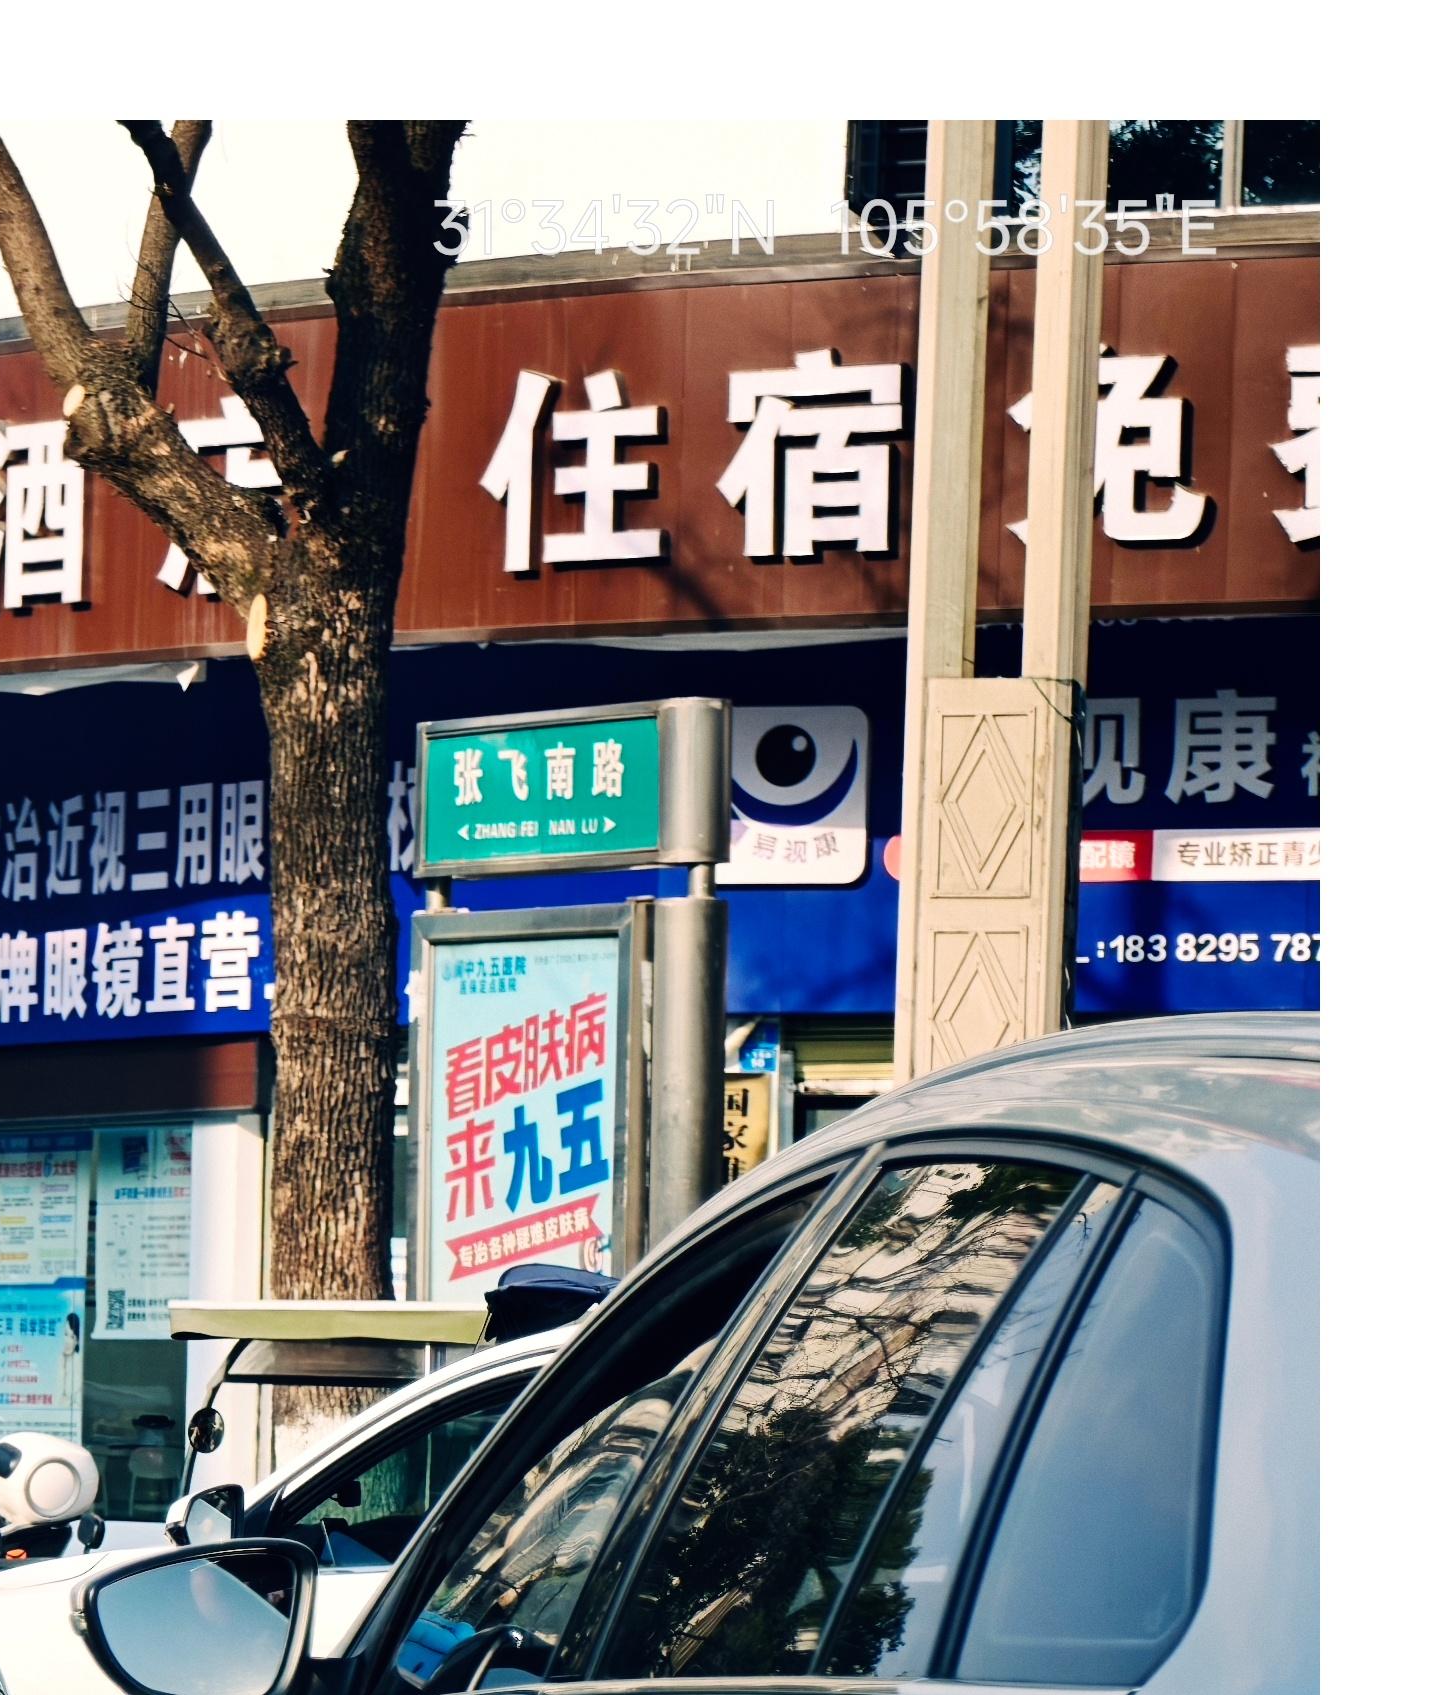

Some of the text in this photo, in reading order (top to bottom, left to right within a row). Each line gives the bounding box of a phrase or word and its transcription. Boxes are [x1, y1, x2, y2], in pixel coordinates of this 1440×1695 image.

[479, 347, 905, 573] 住宿
[453, 738, 624, 806] 张飞南路
[474, 818, 599, 840] ZHANG FEI NAN LU
[1174, 932, 1260, 963] 8295
[445, 991, 608, 1122] 看皮肤病
[458, 1206, 591, 1269] 专治各种疑难皮肤病
